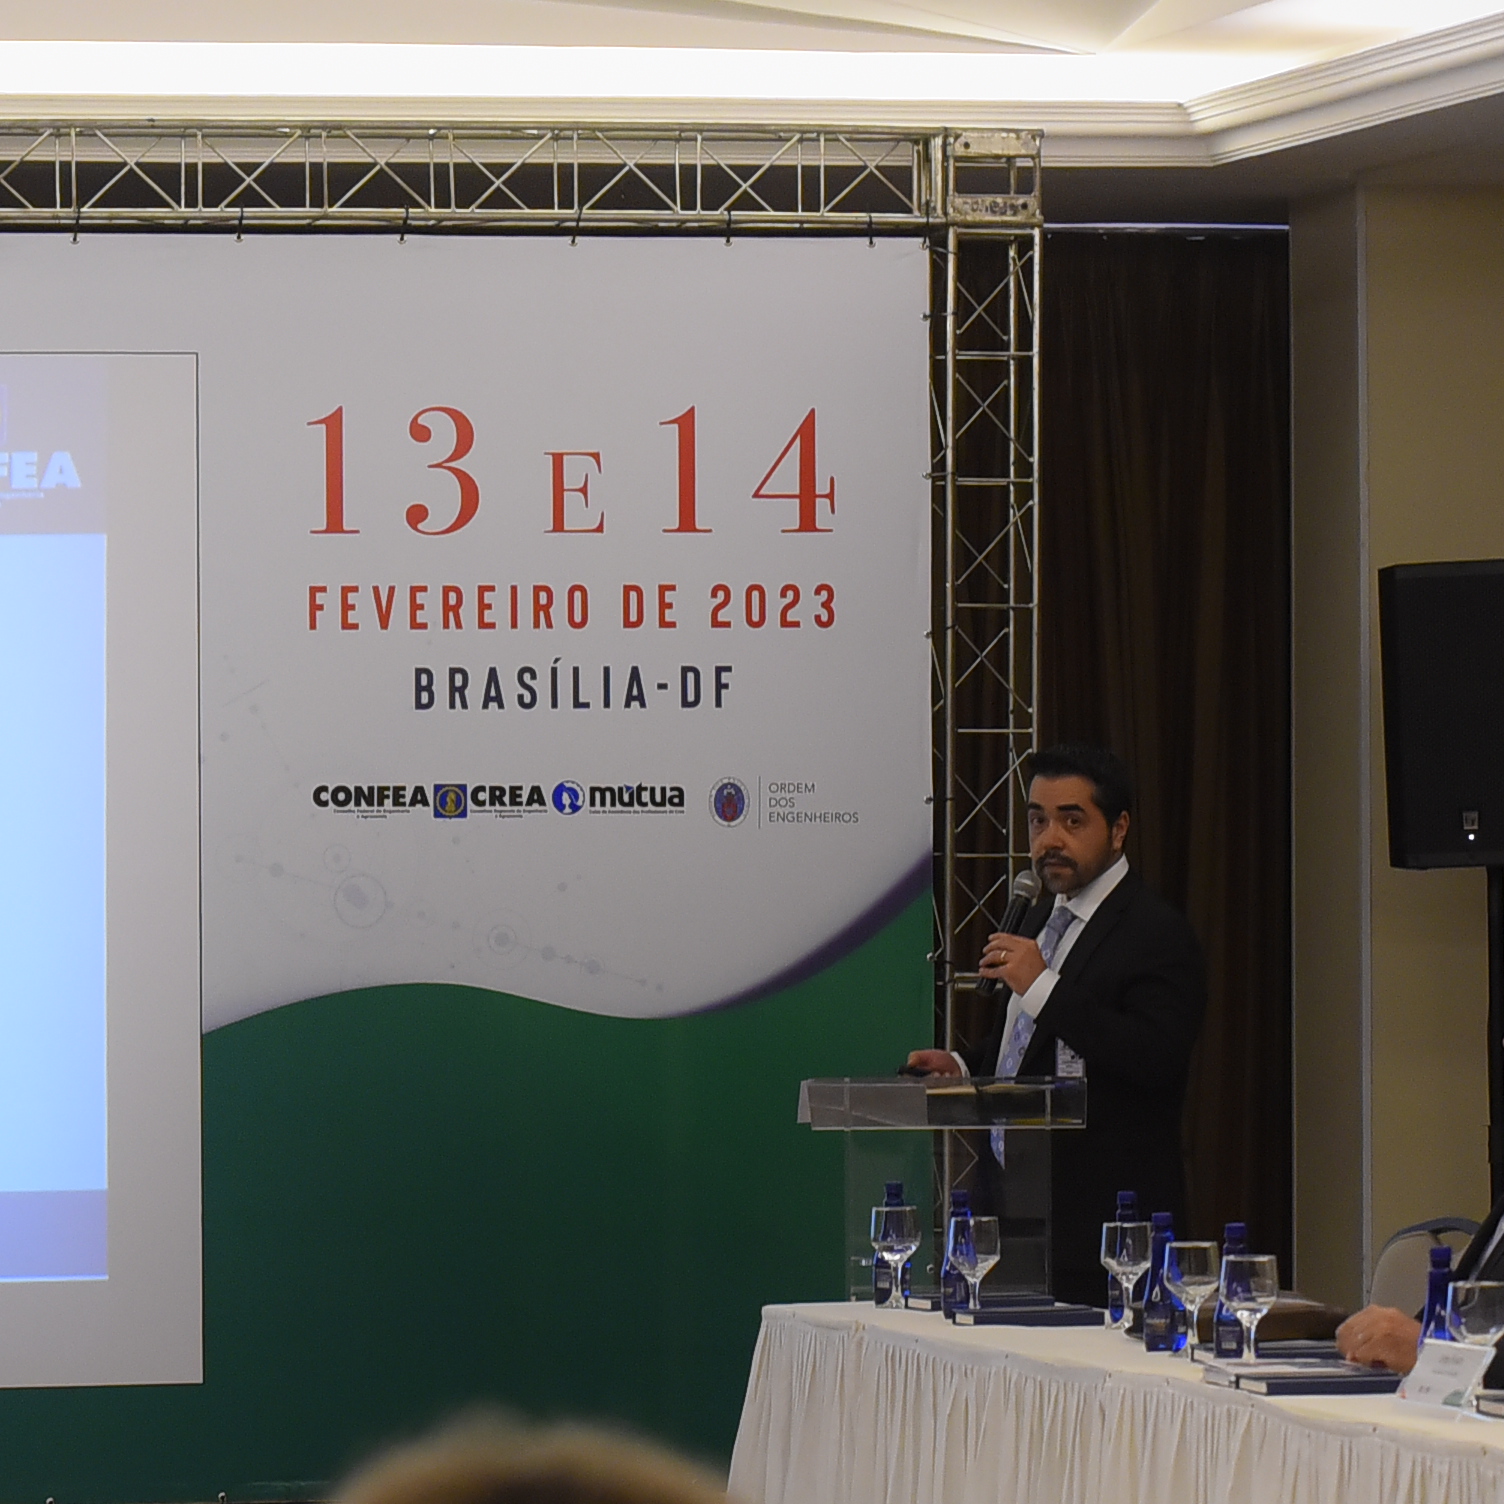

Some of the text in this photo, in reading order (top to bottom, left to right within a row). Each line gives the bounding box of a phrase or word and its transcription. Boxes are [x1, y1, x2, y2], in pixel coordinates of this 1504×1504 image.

[306, 406, 835, 535] 13 E 14
[308, 583, 836, 631] FEVEREIRO DE 2023
[414, 657, 733, 710] BRASÍLIA-DF
[313, 785, 430, 807] CONFEA
[470, 785, 547, 807] CREA
[768, 782, 815, 794] ORDEM
[768, 797, 795, 808] DOS
[768, 812, 859, 823] ENGENHEIROS
